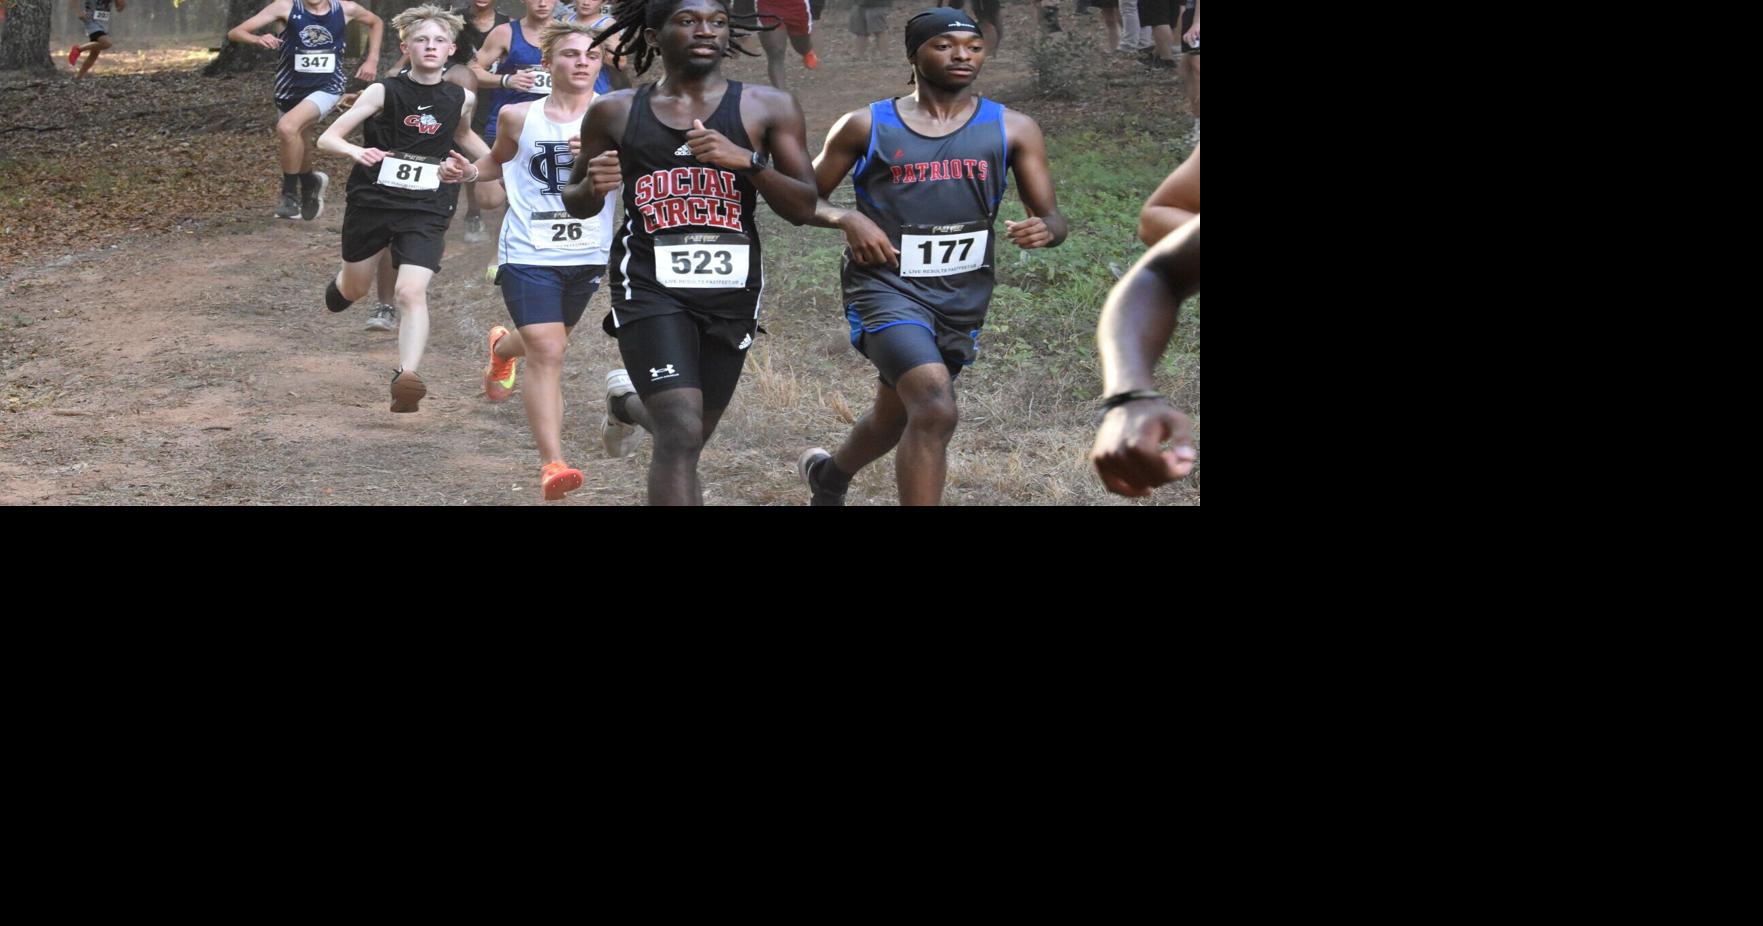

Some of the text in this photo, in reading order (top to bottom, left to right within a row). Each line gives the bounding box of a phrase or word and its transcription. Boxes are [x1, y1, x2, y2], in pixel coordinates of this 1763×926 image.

[301, 56, 329, 67] 347
[396, 163, 423, 183] 81
[890, 159, 988, 184] PATRIOTS
[635, 167, 741, 206] SOCIAL
[639, 197, 743, 234] CIRCLE
[551, 223, 583, 241] 26
[671, 250, 733, 275] 523
[918, 238, 975, 265] 177
